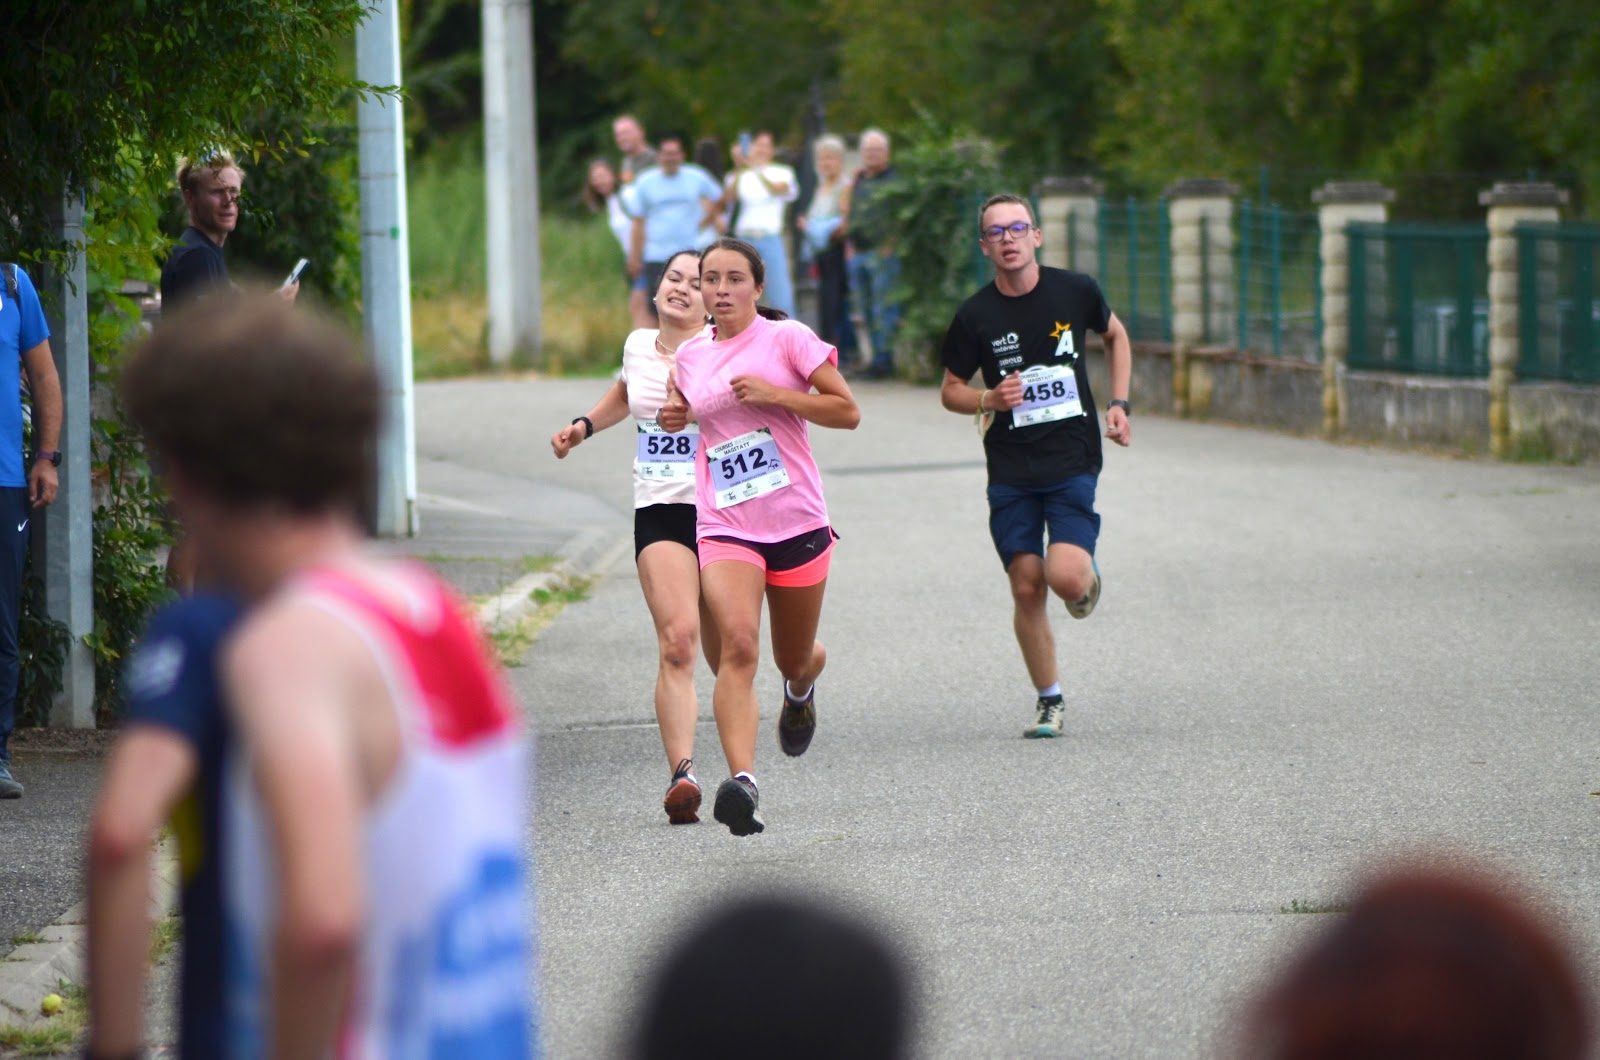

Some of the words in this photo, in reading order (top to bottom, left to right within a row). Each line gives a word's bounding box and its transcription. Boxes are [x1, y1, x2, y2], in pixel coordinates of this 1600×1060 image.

[992, 336, 1007, 347] vert
[1023, 380, 1065, 403] 458
[647, 436, 690, 455] 528
[714, 441, 734, 453] COURSES
[723, 441, 750, 455] MAGSTATT
[721, 447, 768, 480] 512
